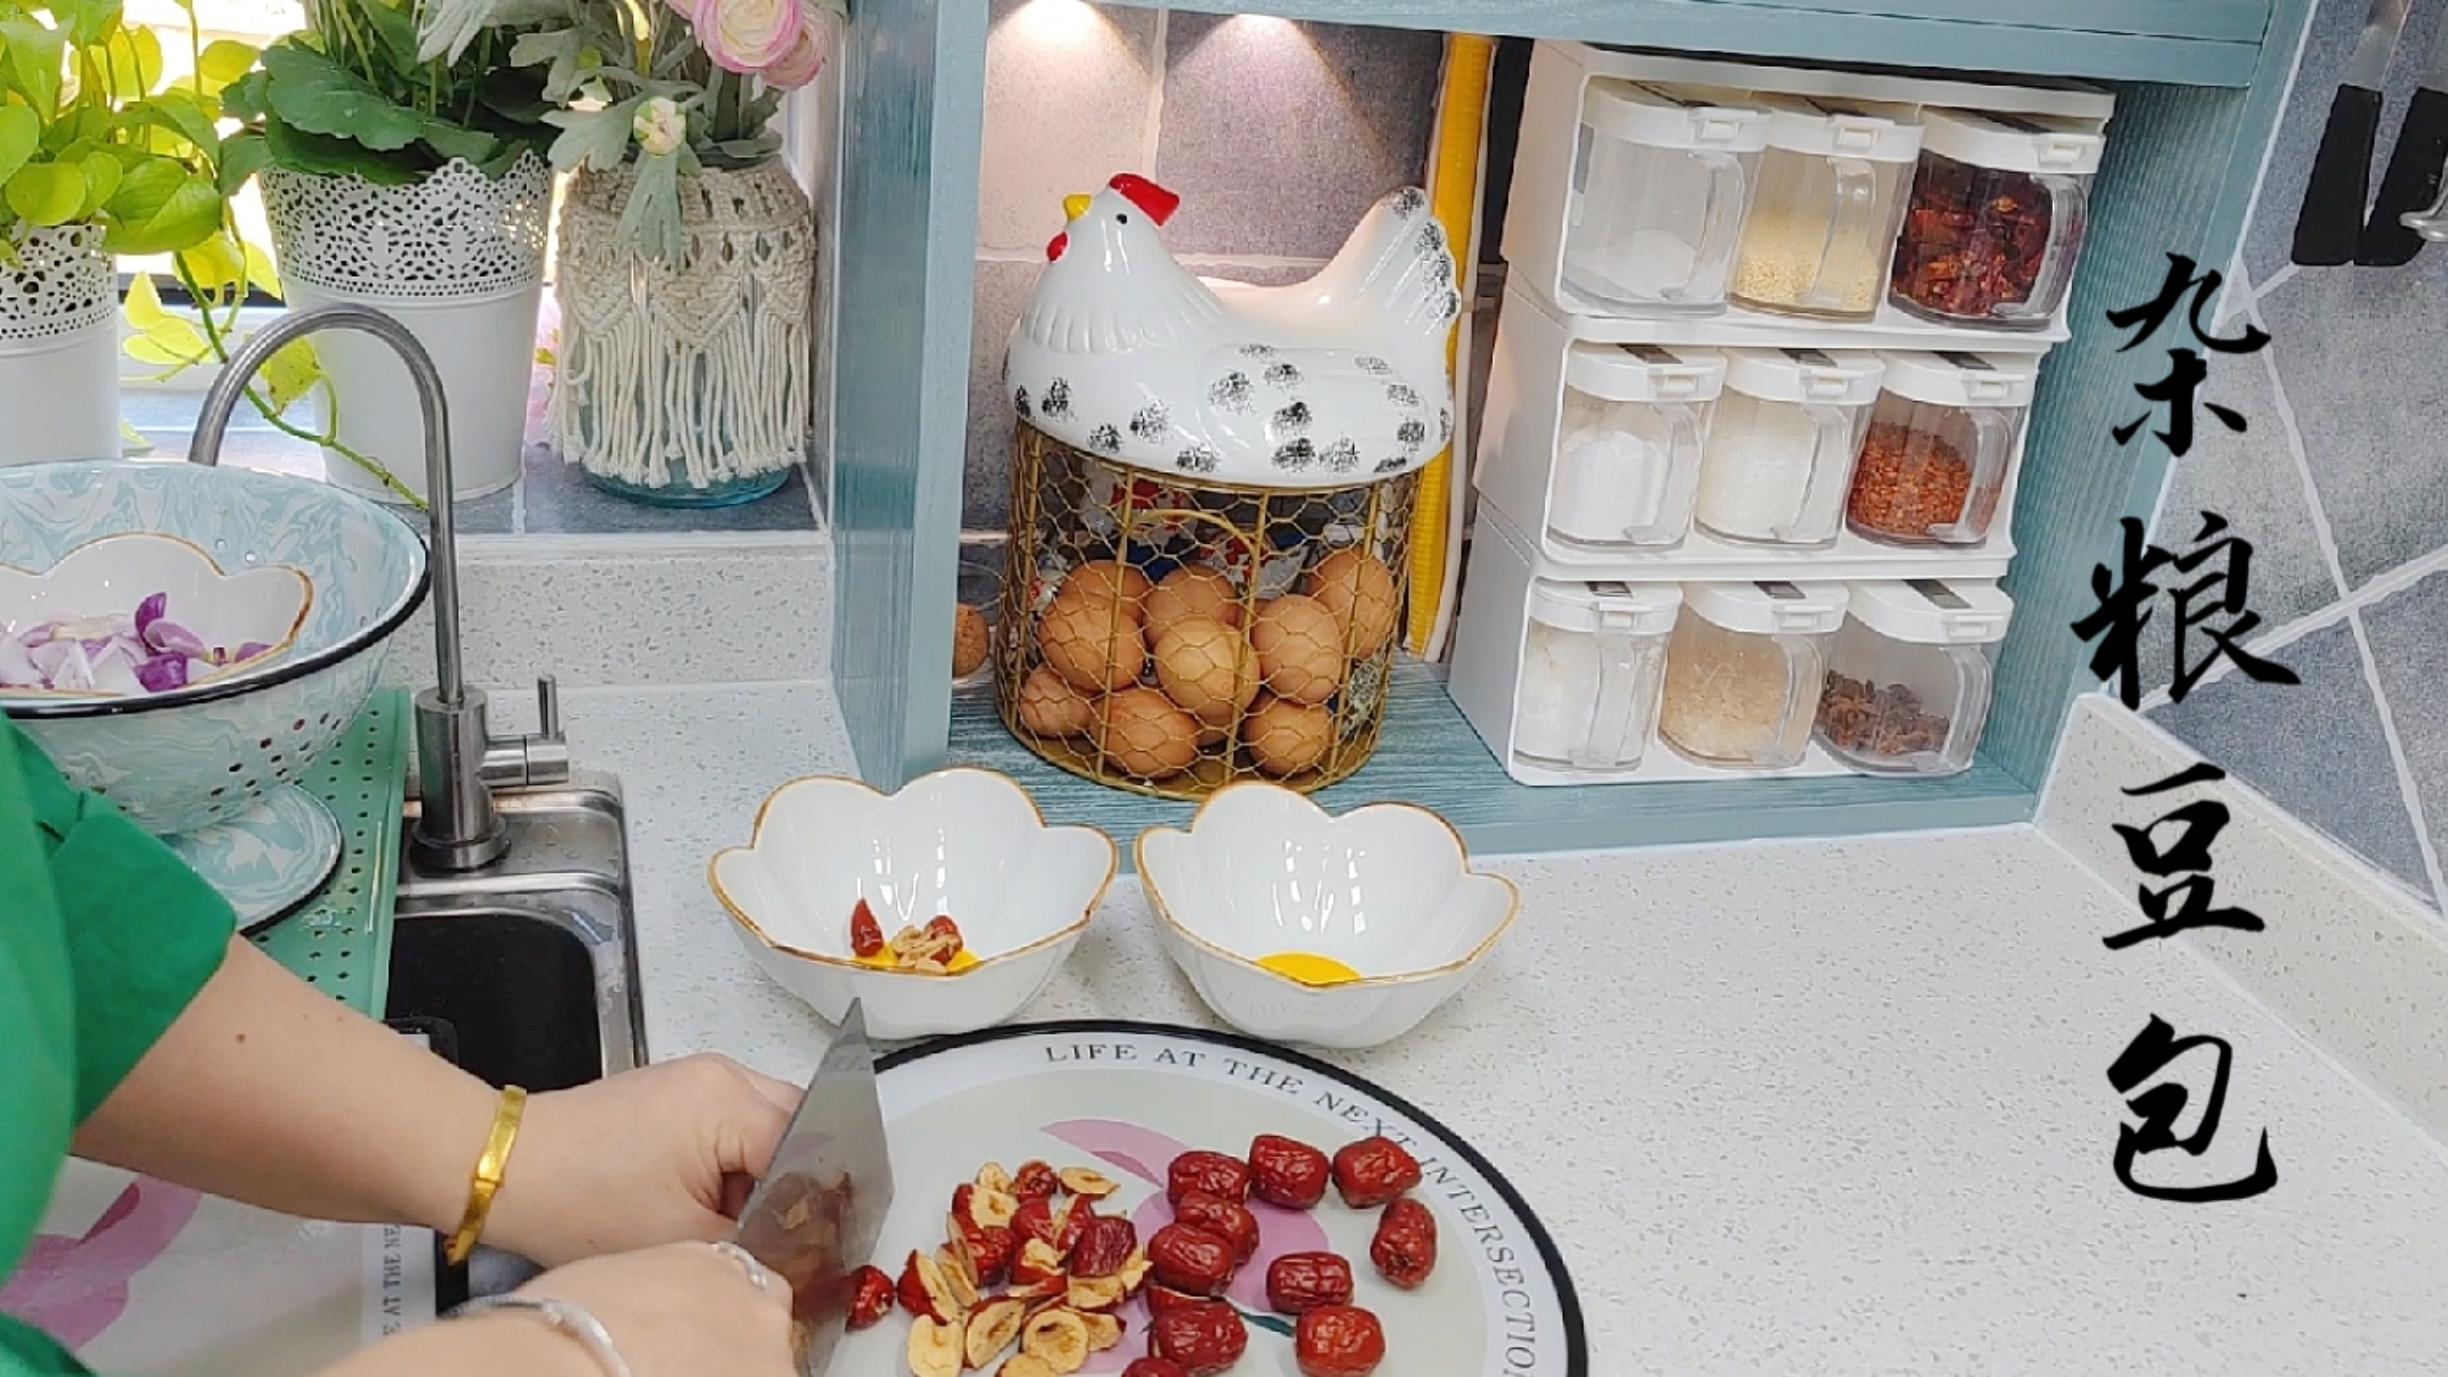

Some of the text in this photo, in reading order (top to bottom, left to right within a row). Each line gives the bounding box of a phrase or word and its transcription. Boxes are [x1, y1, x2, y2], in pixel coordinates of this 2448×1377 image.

[1045, 1043, 1536, 1377] LIFE AT THE NEXT INTERSECTIO
[382, 1253, 402, 1290] THE
[382, 1296, 402, 1316] AT
